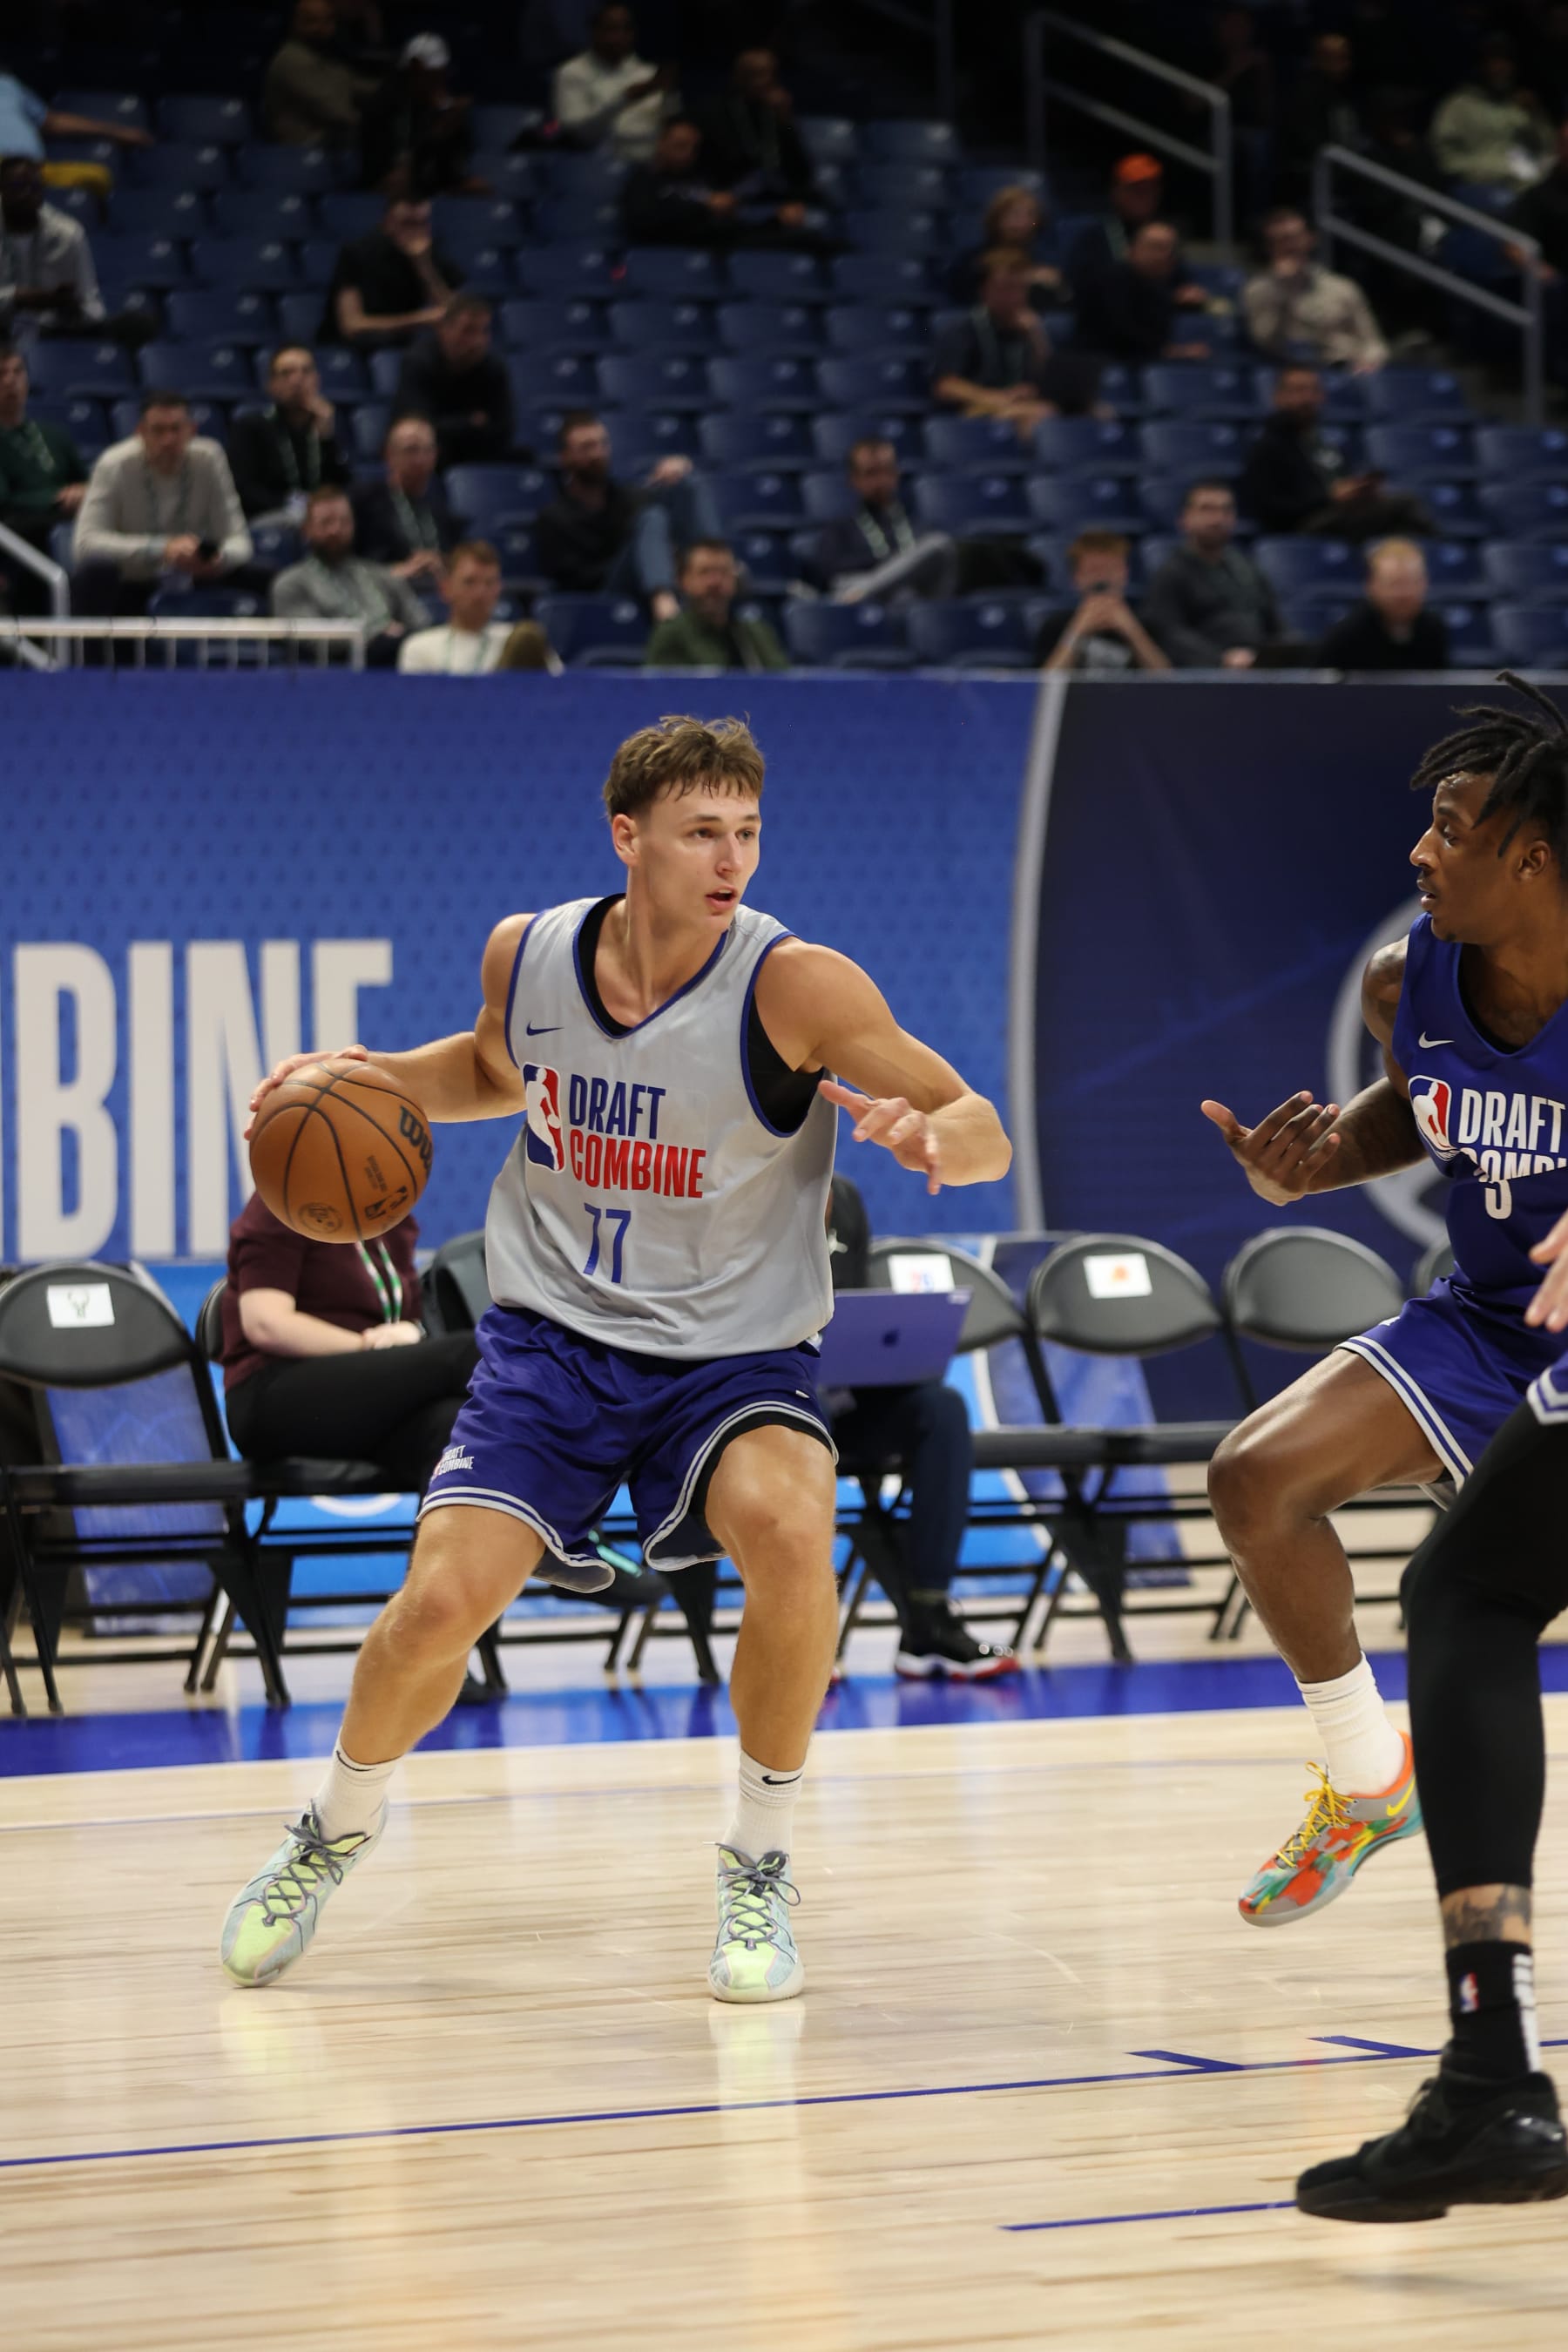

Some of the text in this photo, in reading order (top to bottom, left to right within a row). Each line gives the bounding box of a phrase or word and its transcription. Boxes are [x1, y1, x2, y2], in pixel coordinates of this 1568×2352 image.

[569, 1073, 666, 1139] DRAFT
[1457, 1088, 1565, 1153] DRAFT
[570, 1129, 706, 1199] COMBINE
[583, 1202, 632, 1284] 77
